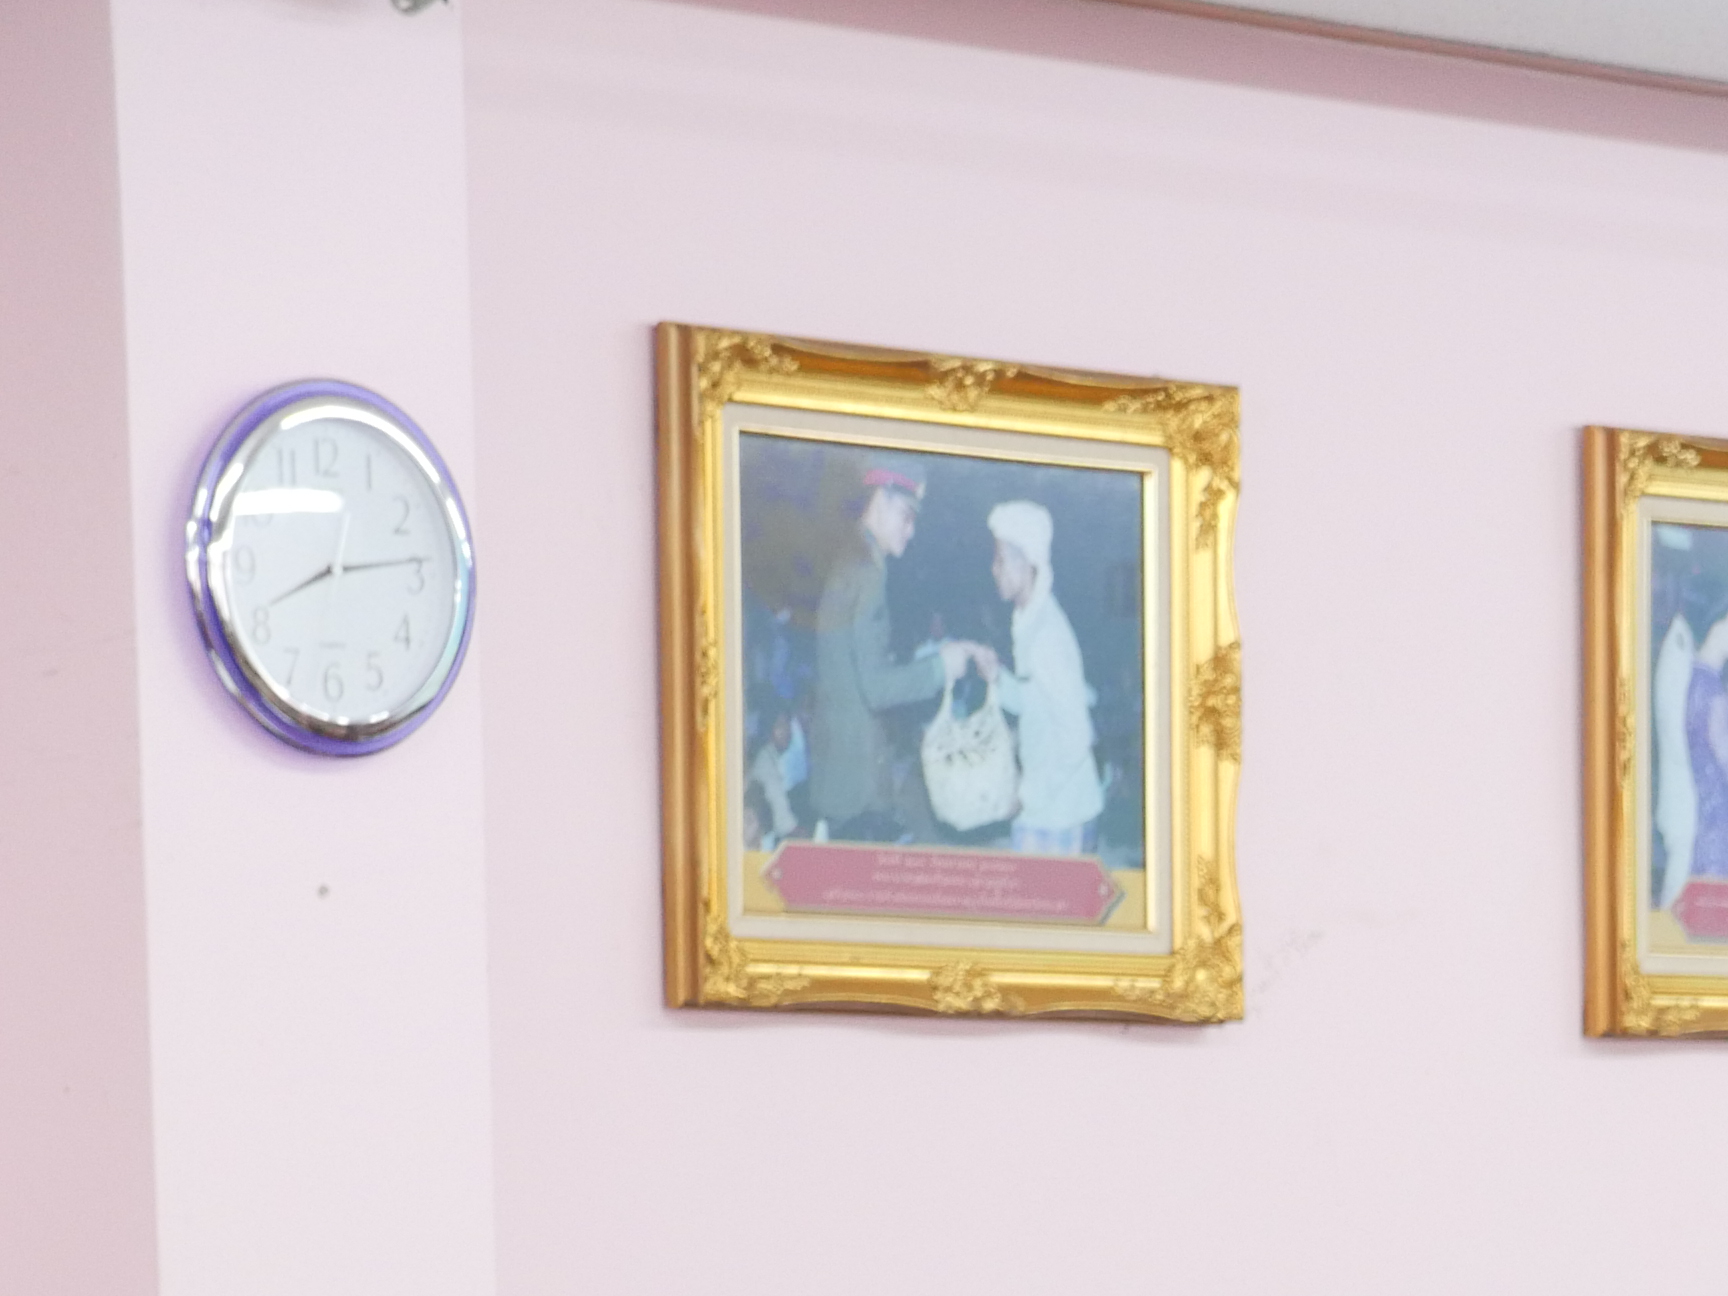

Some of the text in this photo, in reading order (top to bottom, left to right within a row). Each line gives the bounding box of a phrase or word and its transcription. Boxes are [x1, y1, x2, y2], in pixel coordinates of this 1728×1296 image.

[276, 448, 298, 486] 11
[312, 436, 341, 478] 12
[392, 496, 412, 535] 2
[234, 545, 256, 586] 9
[407, 557, 425, 595] 3
[252, 605, 272, 645] 8
[393, 613, 412, 650] 4
[283, 648, 300, 687] 7
[322, 662, 345, 701] 6
[364, 652, 384, 692] 5
